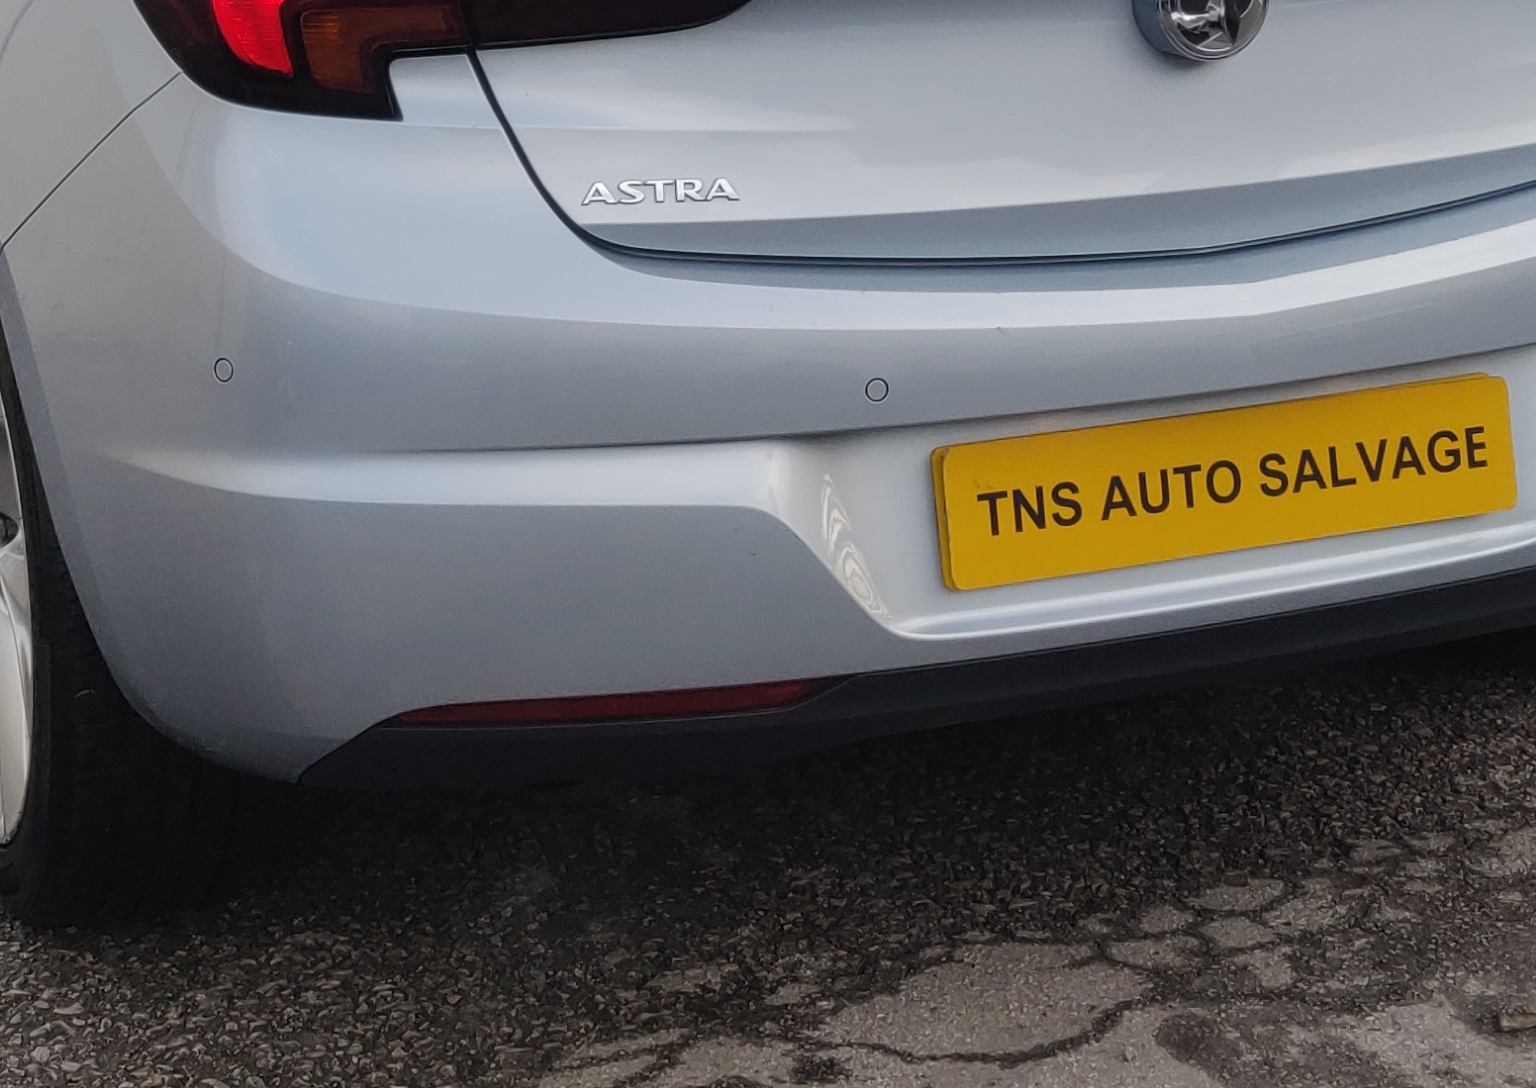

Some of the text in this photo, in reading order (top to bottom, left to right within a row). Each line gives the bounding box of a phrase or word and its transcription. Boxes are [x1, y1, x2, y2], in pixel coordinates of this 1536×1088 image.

[581, 177, 740, 206] ASTRA
[977, 425, 1489, 537] TNS AUTO SALVAGE
